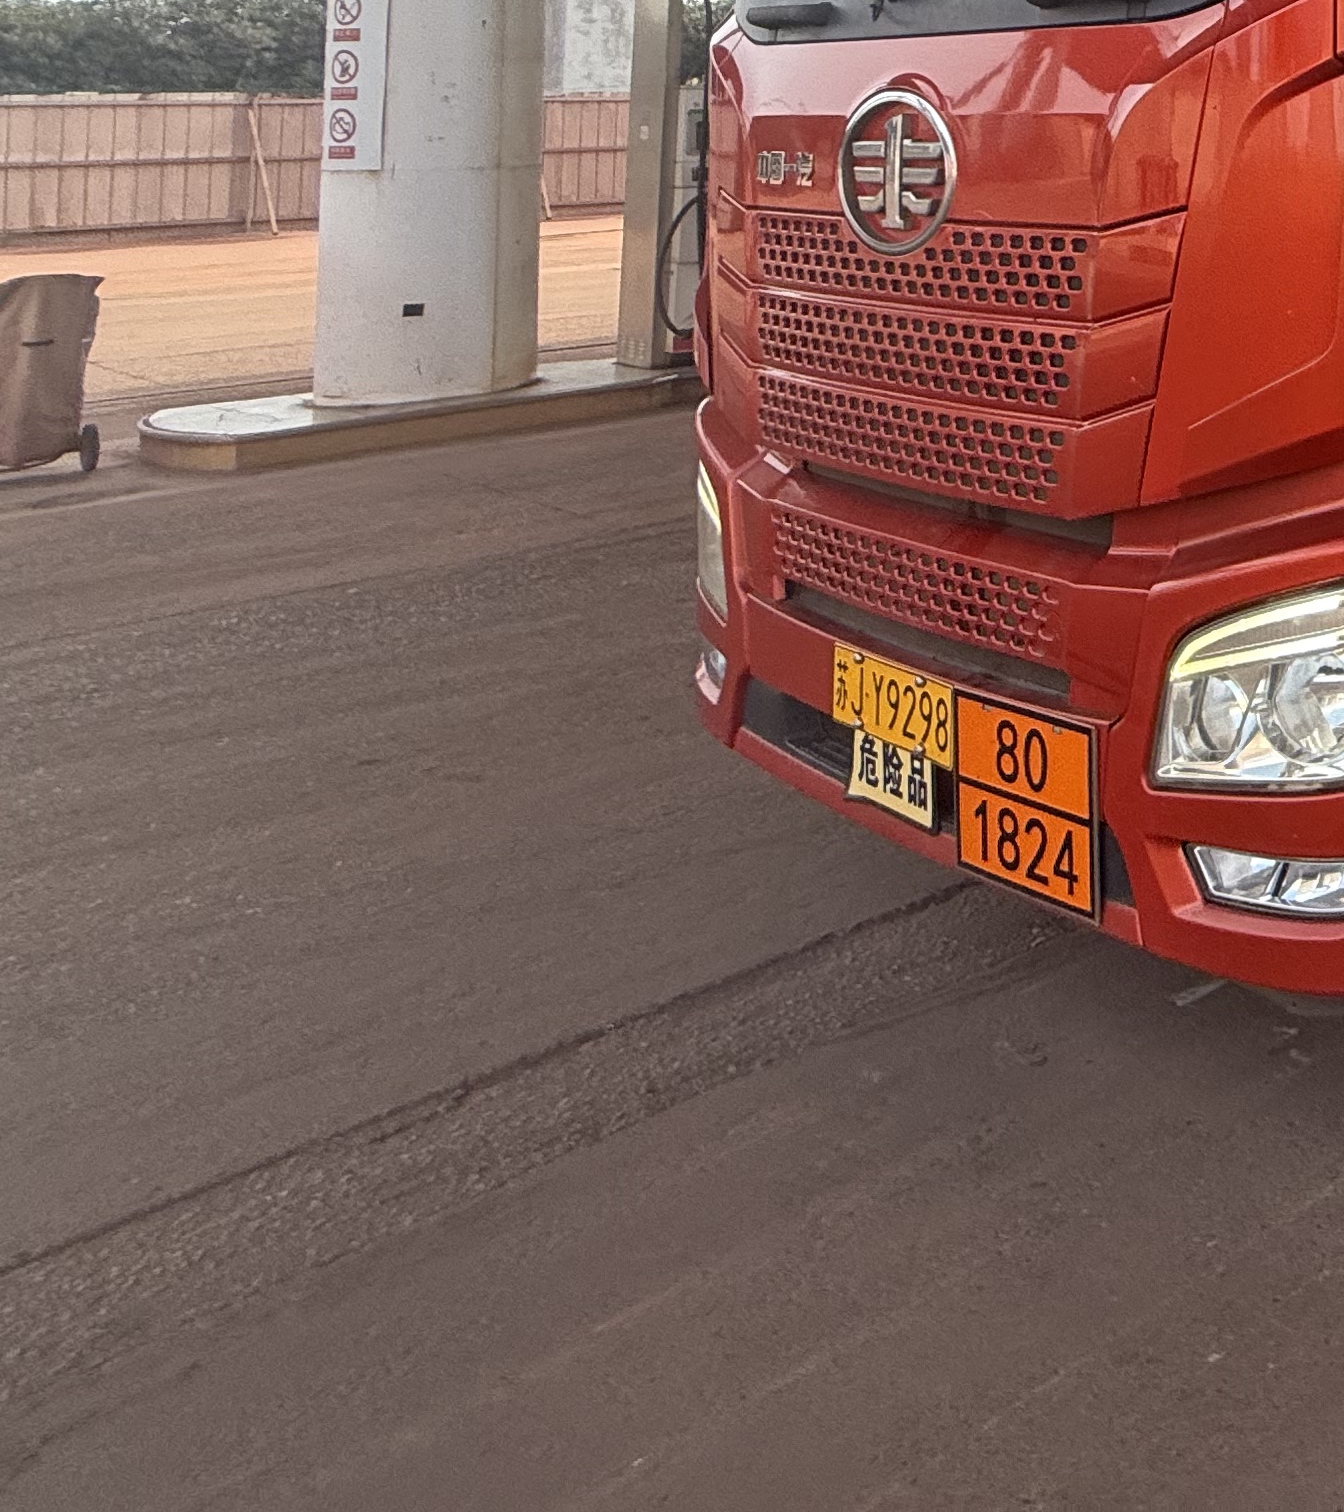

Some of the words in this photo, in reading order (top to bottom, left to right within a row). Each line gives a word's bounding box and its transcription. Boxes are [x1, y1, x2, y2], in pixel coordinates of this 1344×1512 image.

[858, 734, 928, 811] 危险品
[996, 719, 1048, 793] 80
[974, 799, 1078, 896] 1824
